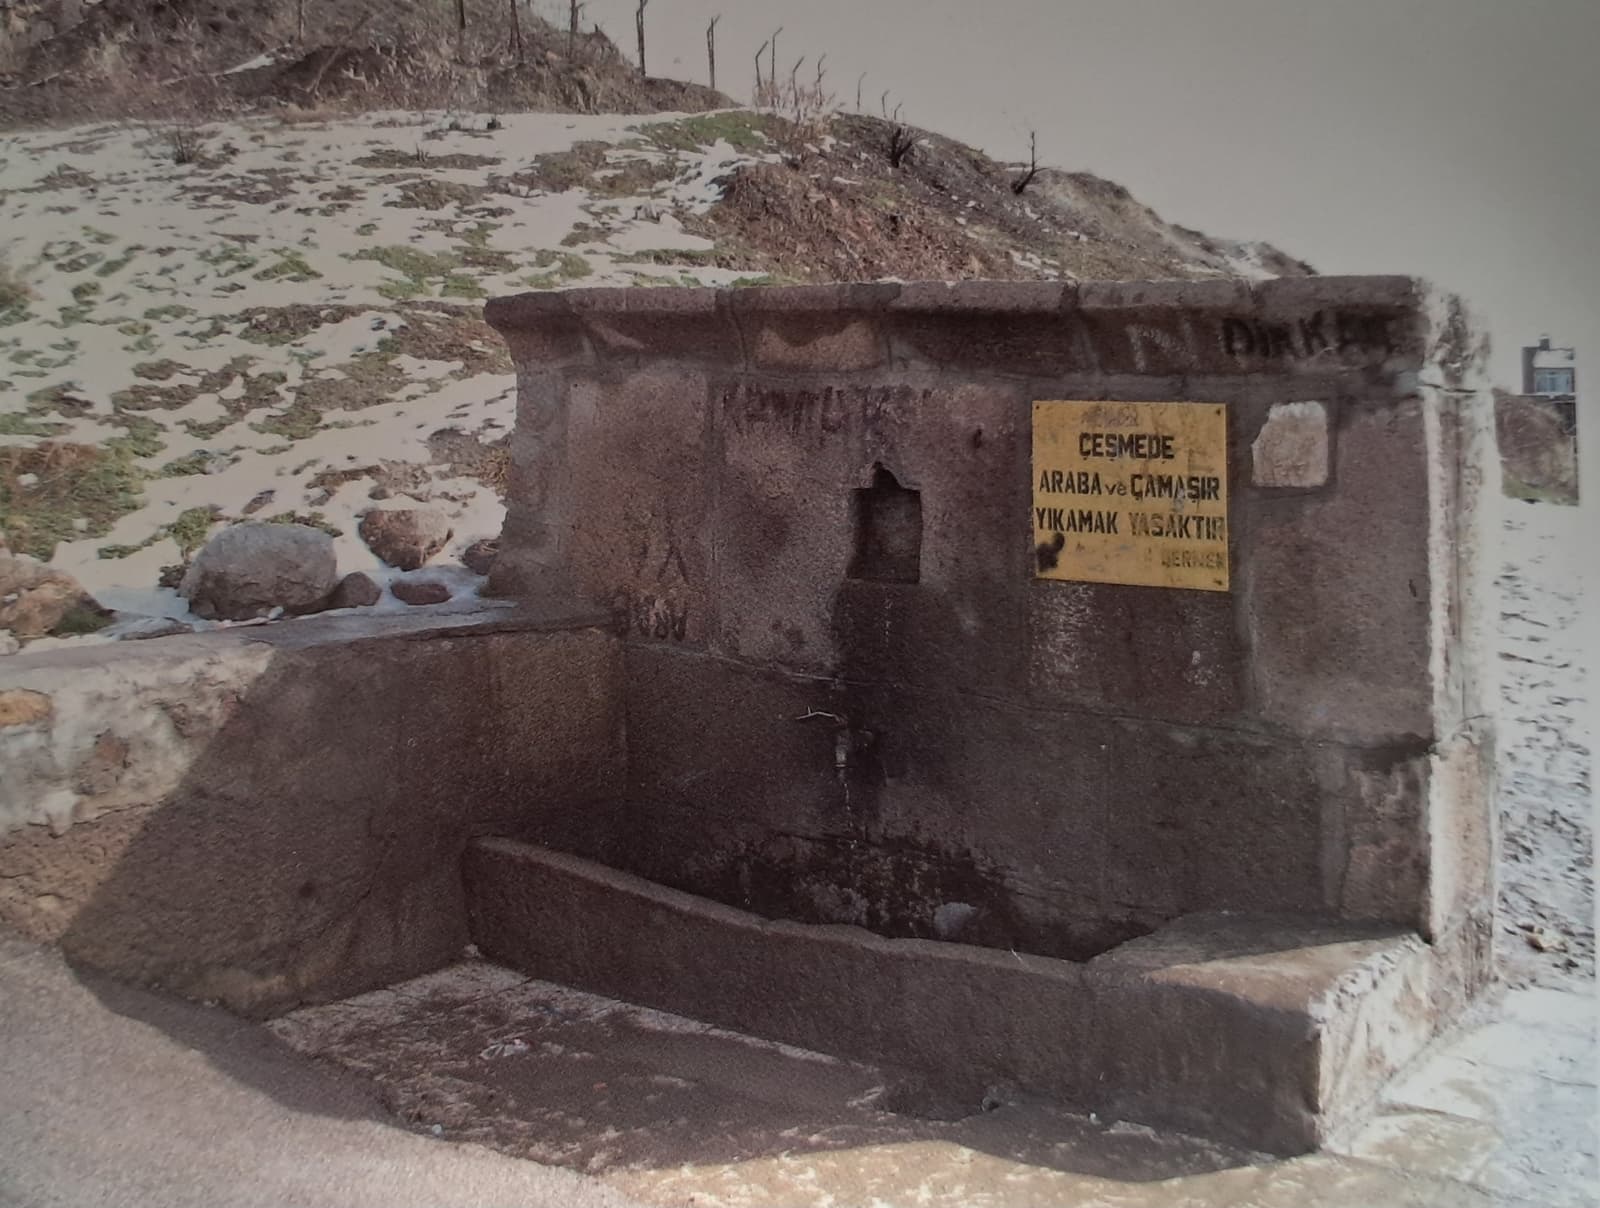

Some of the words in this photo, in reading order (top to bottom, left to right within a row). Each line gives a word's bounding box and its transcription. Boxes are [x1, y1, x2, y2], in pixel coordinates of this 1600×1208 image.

[1079, 432, 1175, 463] ÇEŞMEDE
[1039, 470, 1102, 495] ARABA
[1104, 482, 1127, 496] ve
[1130, 474, 1220, 503] ÇAMAŞIR
[1035, 507, 1118, 534] YIKAMAK
[1128, 511, 1225, 541] YASAKTIR
